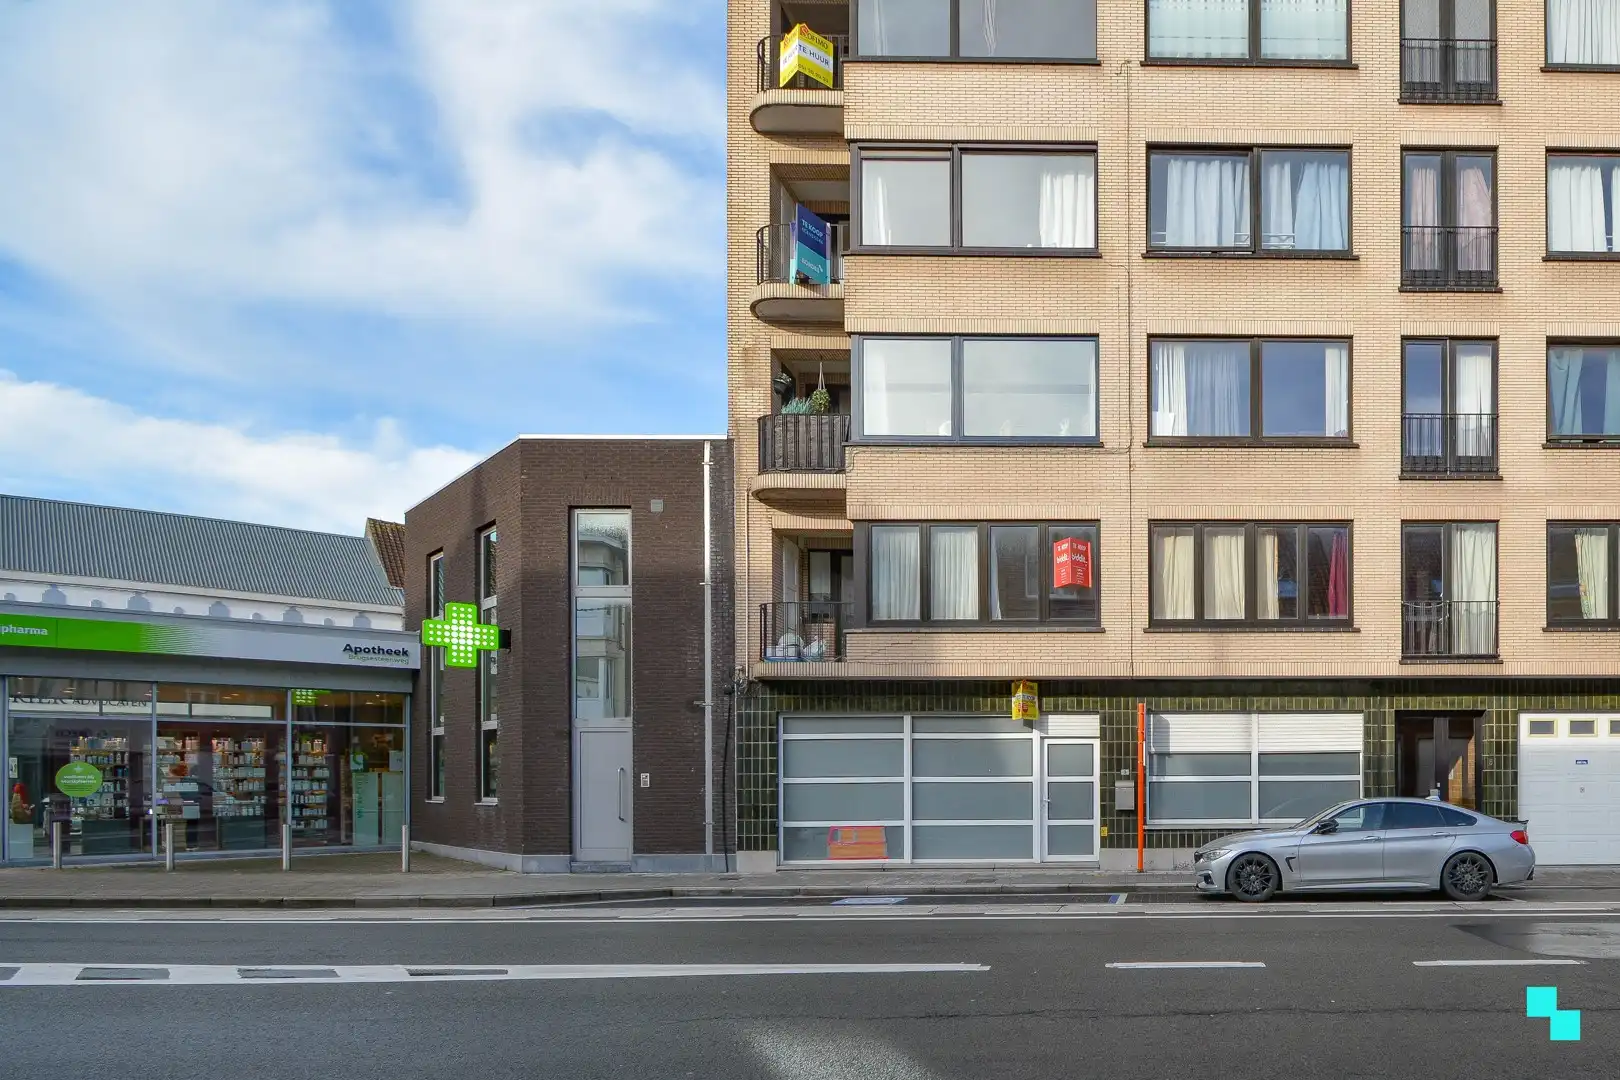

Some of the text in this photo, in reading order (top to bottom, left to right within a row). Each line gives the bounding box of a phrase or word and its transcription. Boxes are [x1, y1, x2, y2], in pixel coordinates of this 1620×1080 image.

[799, 44, 807, 54] TE
[809, 49, 829, 66] HUUR
[801, 218, 808, 229] TE
[808, 223, 824, 236] KOOP
[0, 624, 49, 636] pharma
[342, 643, 409, 657] Apotheek
